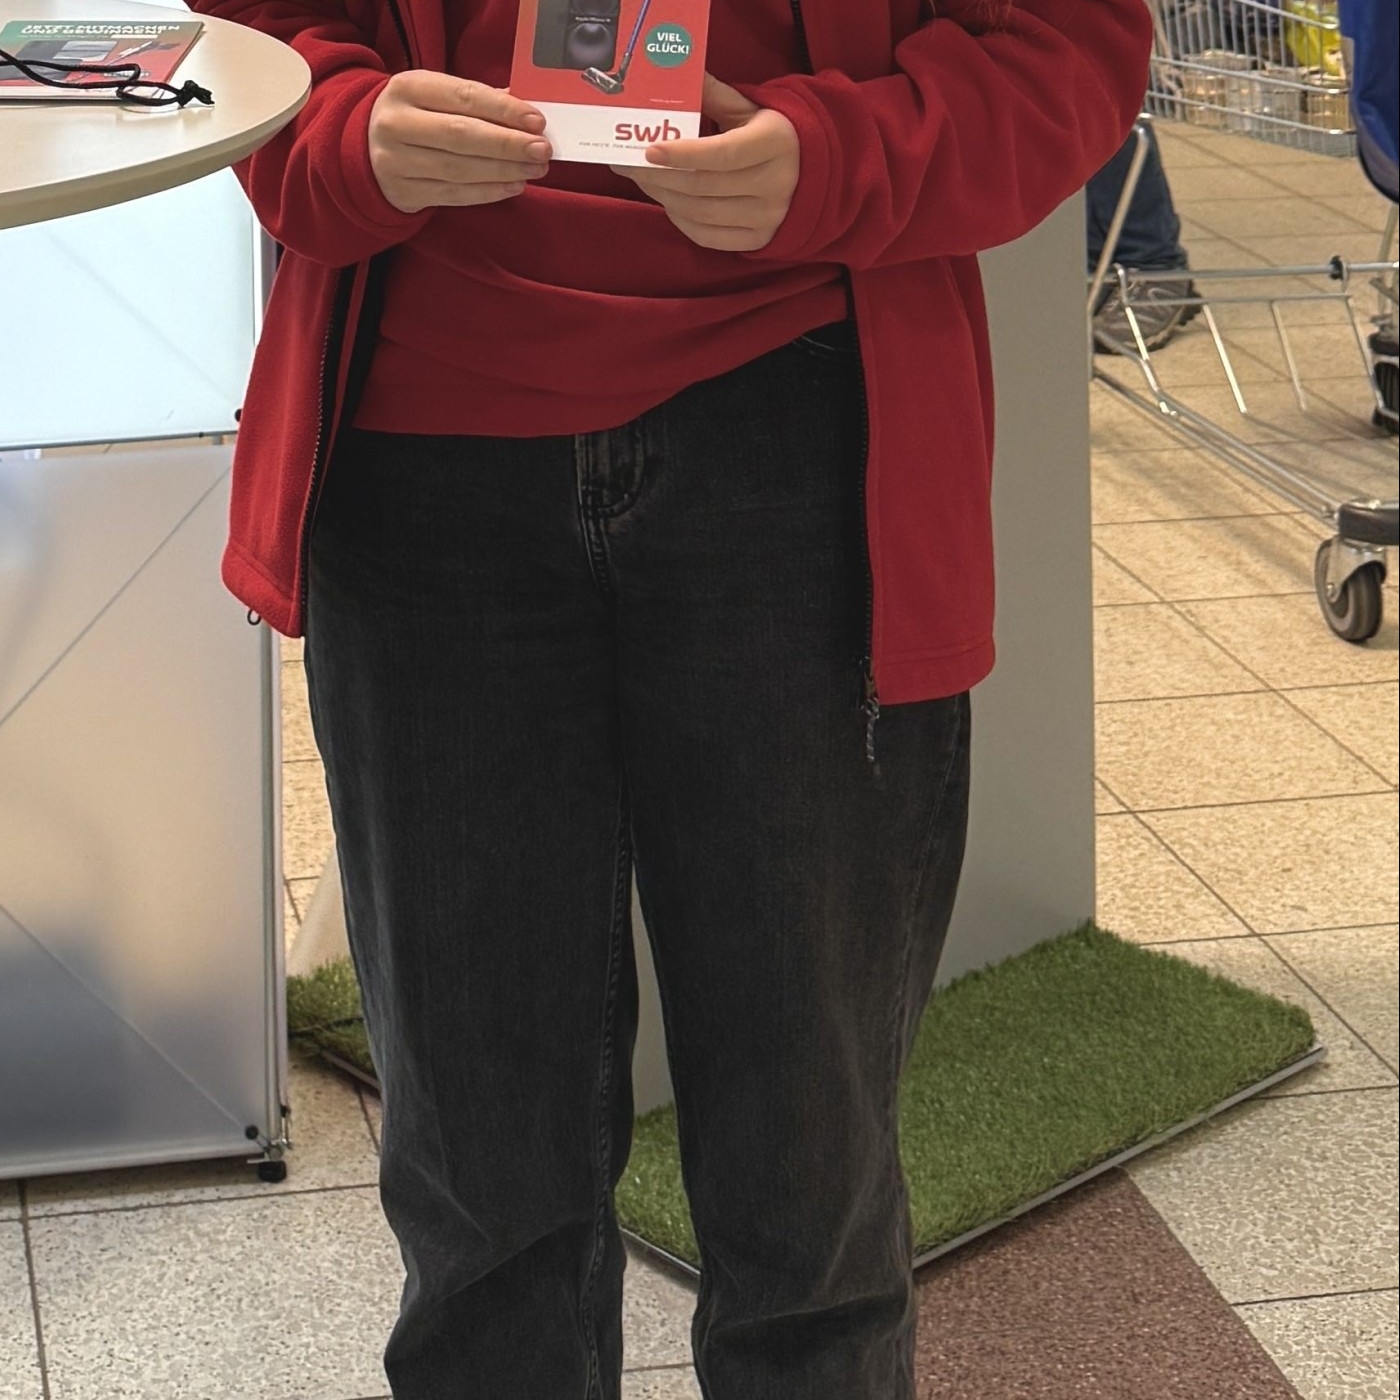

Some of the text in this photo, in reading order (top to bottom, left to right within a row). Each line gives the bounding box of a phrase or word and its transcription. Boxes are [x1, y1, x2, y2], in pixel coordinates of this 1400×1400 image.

[656, 31, 683, 43] VIEL
[646, 41, 690, 55] GLÜCK!
[614, 119, 682, 143] swb
